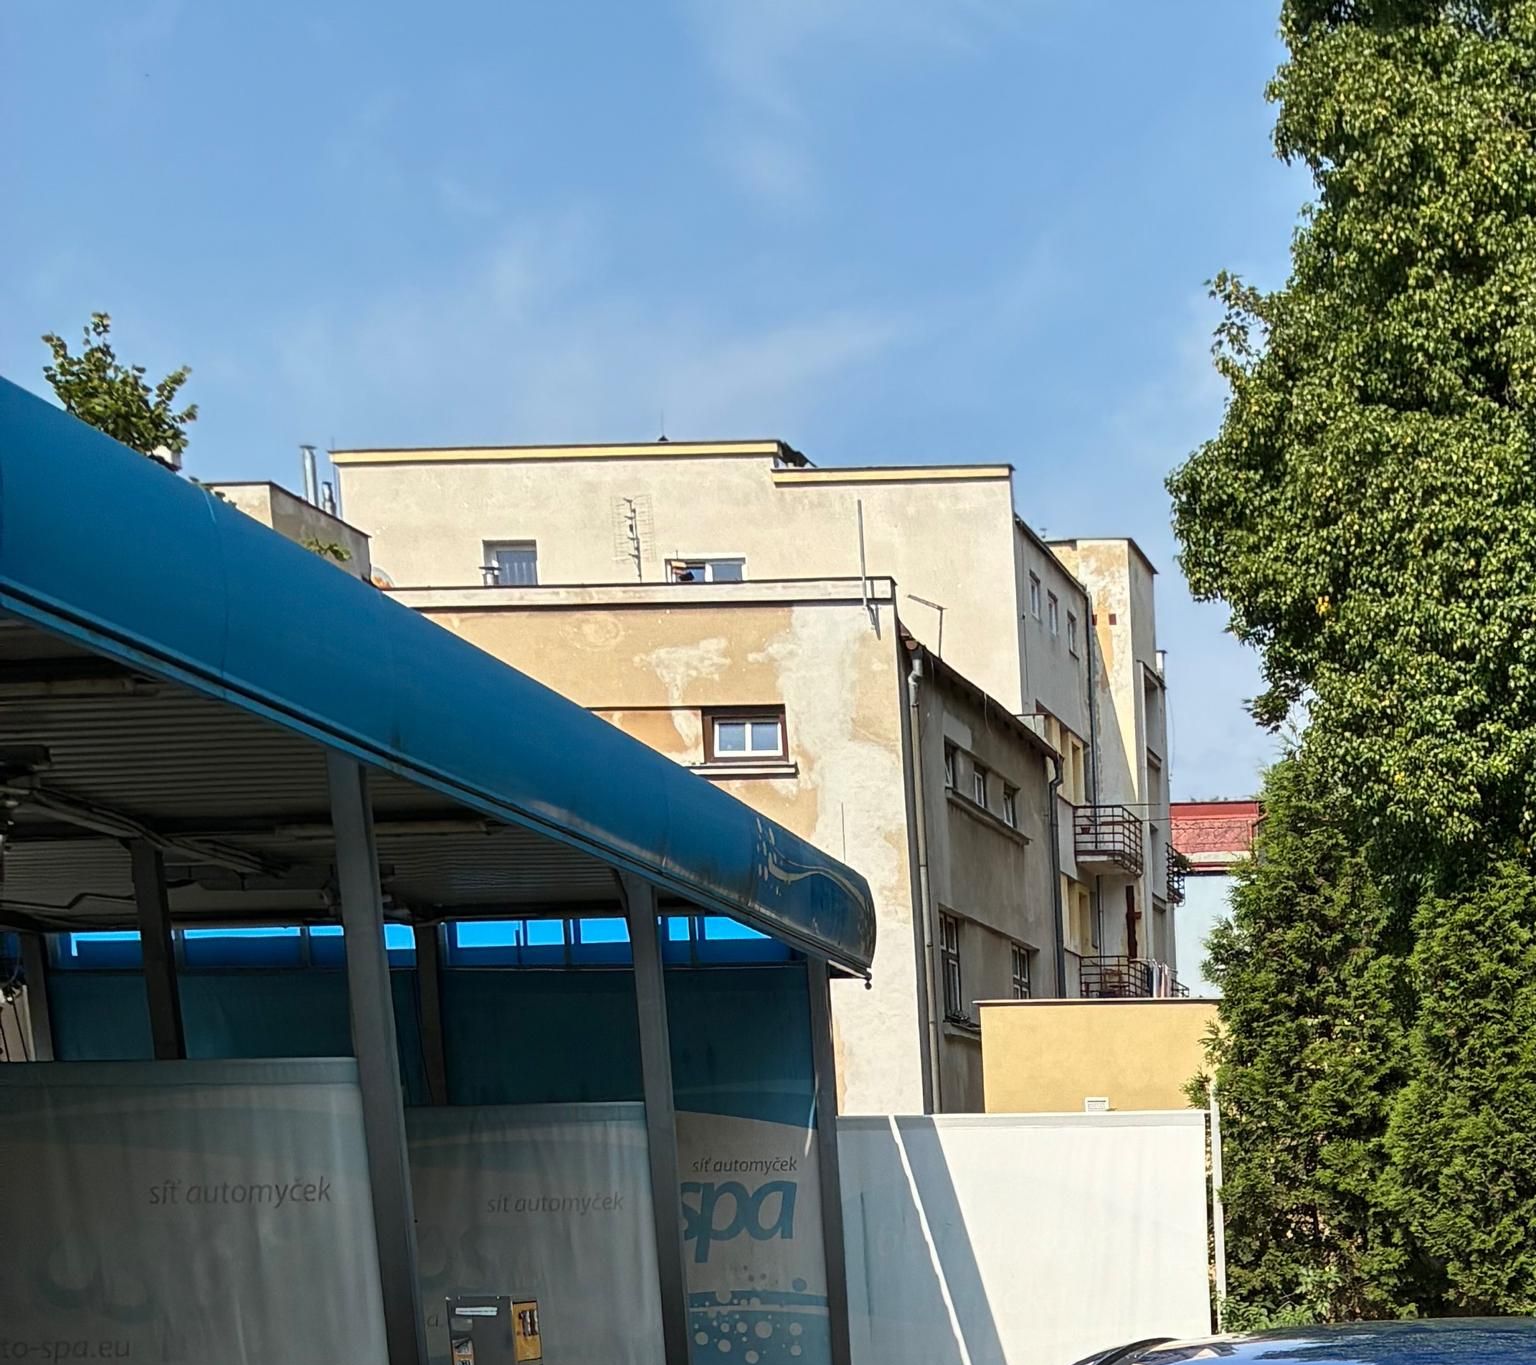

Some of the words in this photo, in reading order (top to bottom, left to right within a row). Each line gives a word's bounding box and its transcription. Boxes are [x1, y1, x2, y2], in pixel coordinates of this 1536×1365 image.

[713, 1156, 798, 1176] automyček
[185, 1175, 331, 1209] automyček
[680, 1180, 798, 1264] spa
